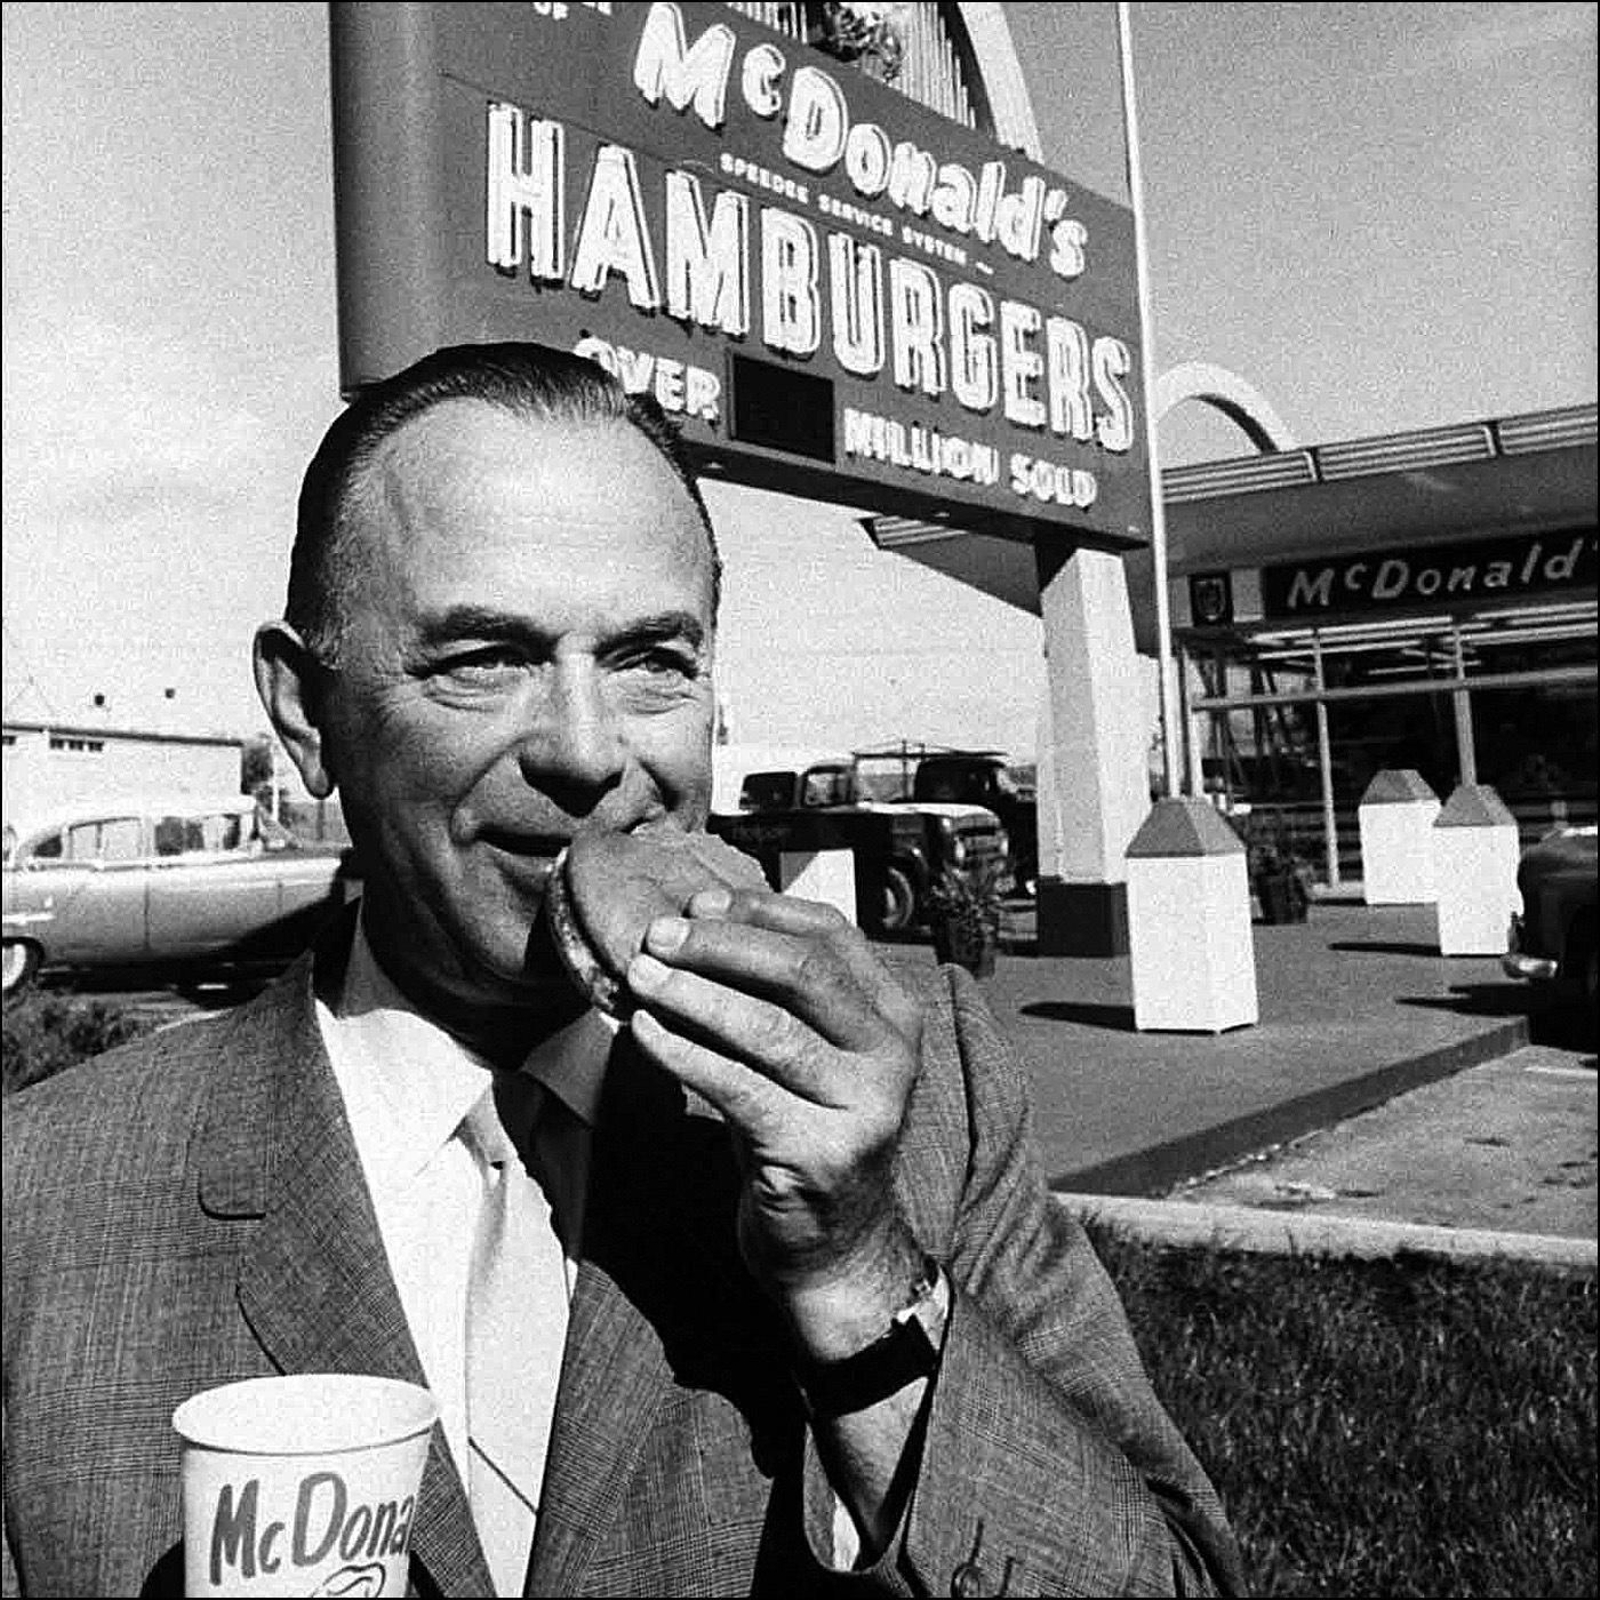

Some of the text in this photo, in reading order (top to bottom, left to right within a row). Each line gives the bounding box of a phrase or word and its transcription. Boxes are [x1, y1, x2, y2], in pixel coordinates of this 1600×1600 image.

[634, 3, 1088, 277] McDonald's
[818, 193, 894, 236] SERVICE
[902, 226, 967, 265] SYSTEM
[487, 102, 1134, 452] HAMBURGERS
[844, 408, 999, 486] MILLION
[1010, 452, 1097, 507] SOLD
